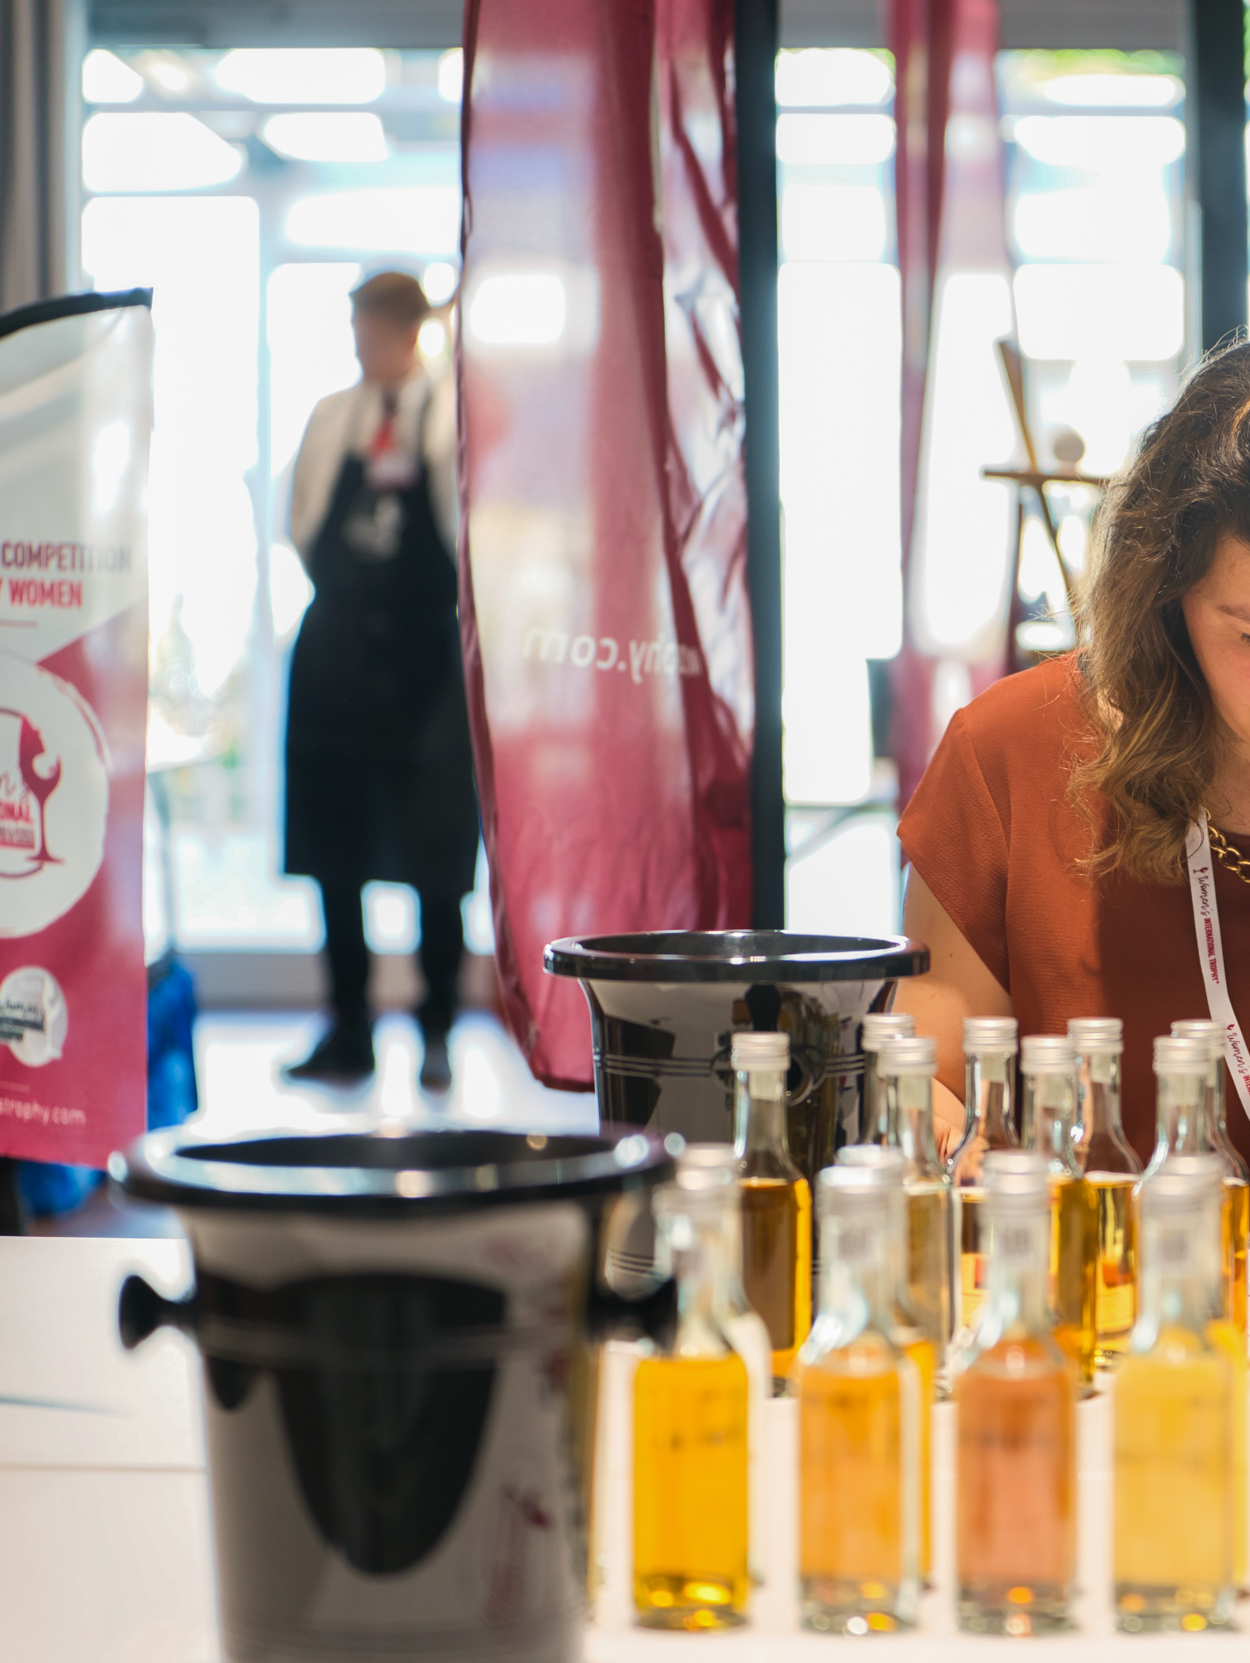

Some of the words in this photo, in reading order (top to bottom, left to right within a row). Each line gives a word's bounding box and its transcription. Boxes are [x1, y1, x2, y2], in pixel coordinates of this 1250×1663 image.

[2, 540, 131, 572] COMPETITION
[8, 577, 83, 608] WOMEN
[1197, 876, 1214, 917] Women's
[1204, 918, 1216, 958] INTERNATIONAL
[1226, 1032, 1250, 1075] Women's
